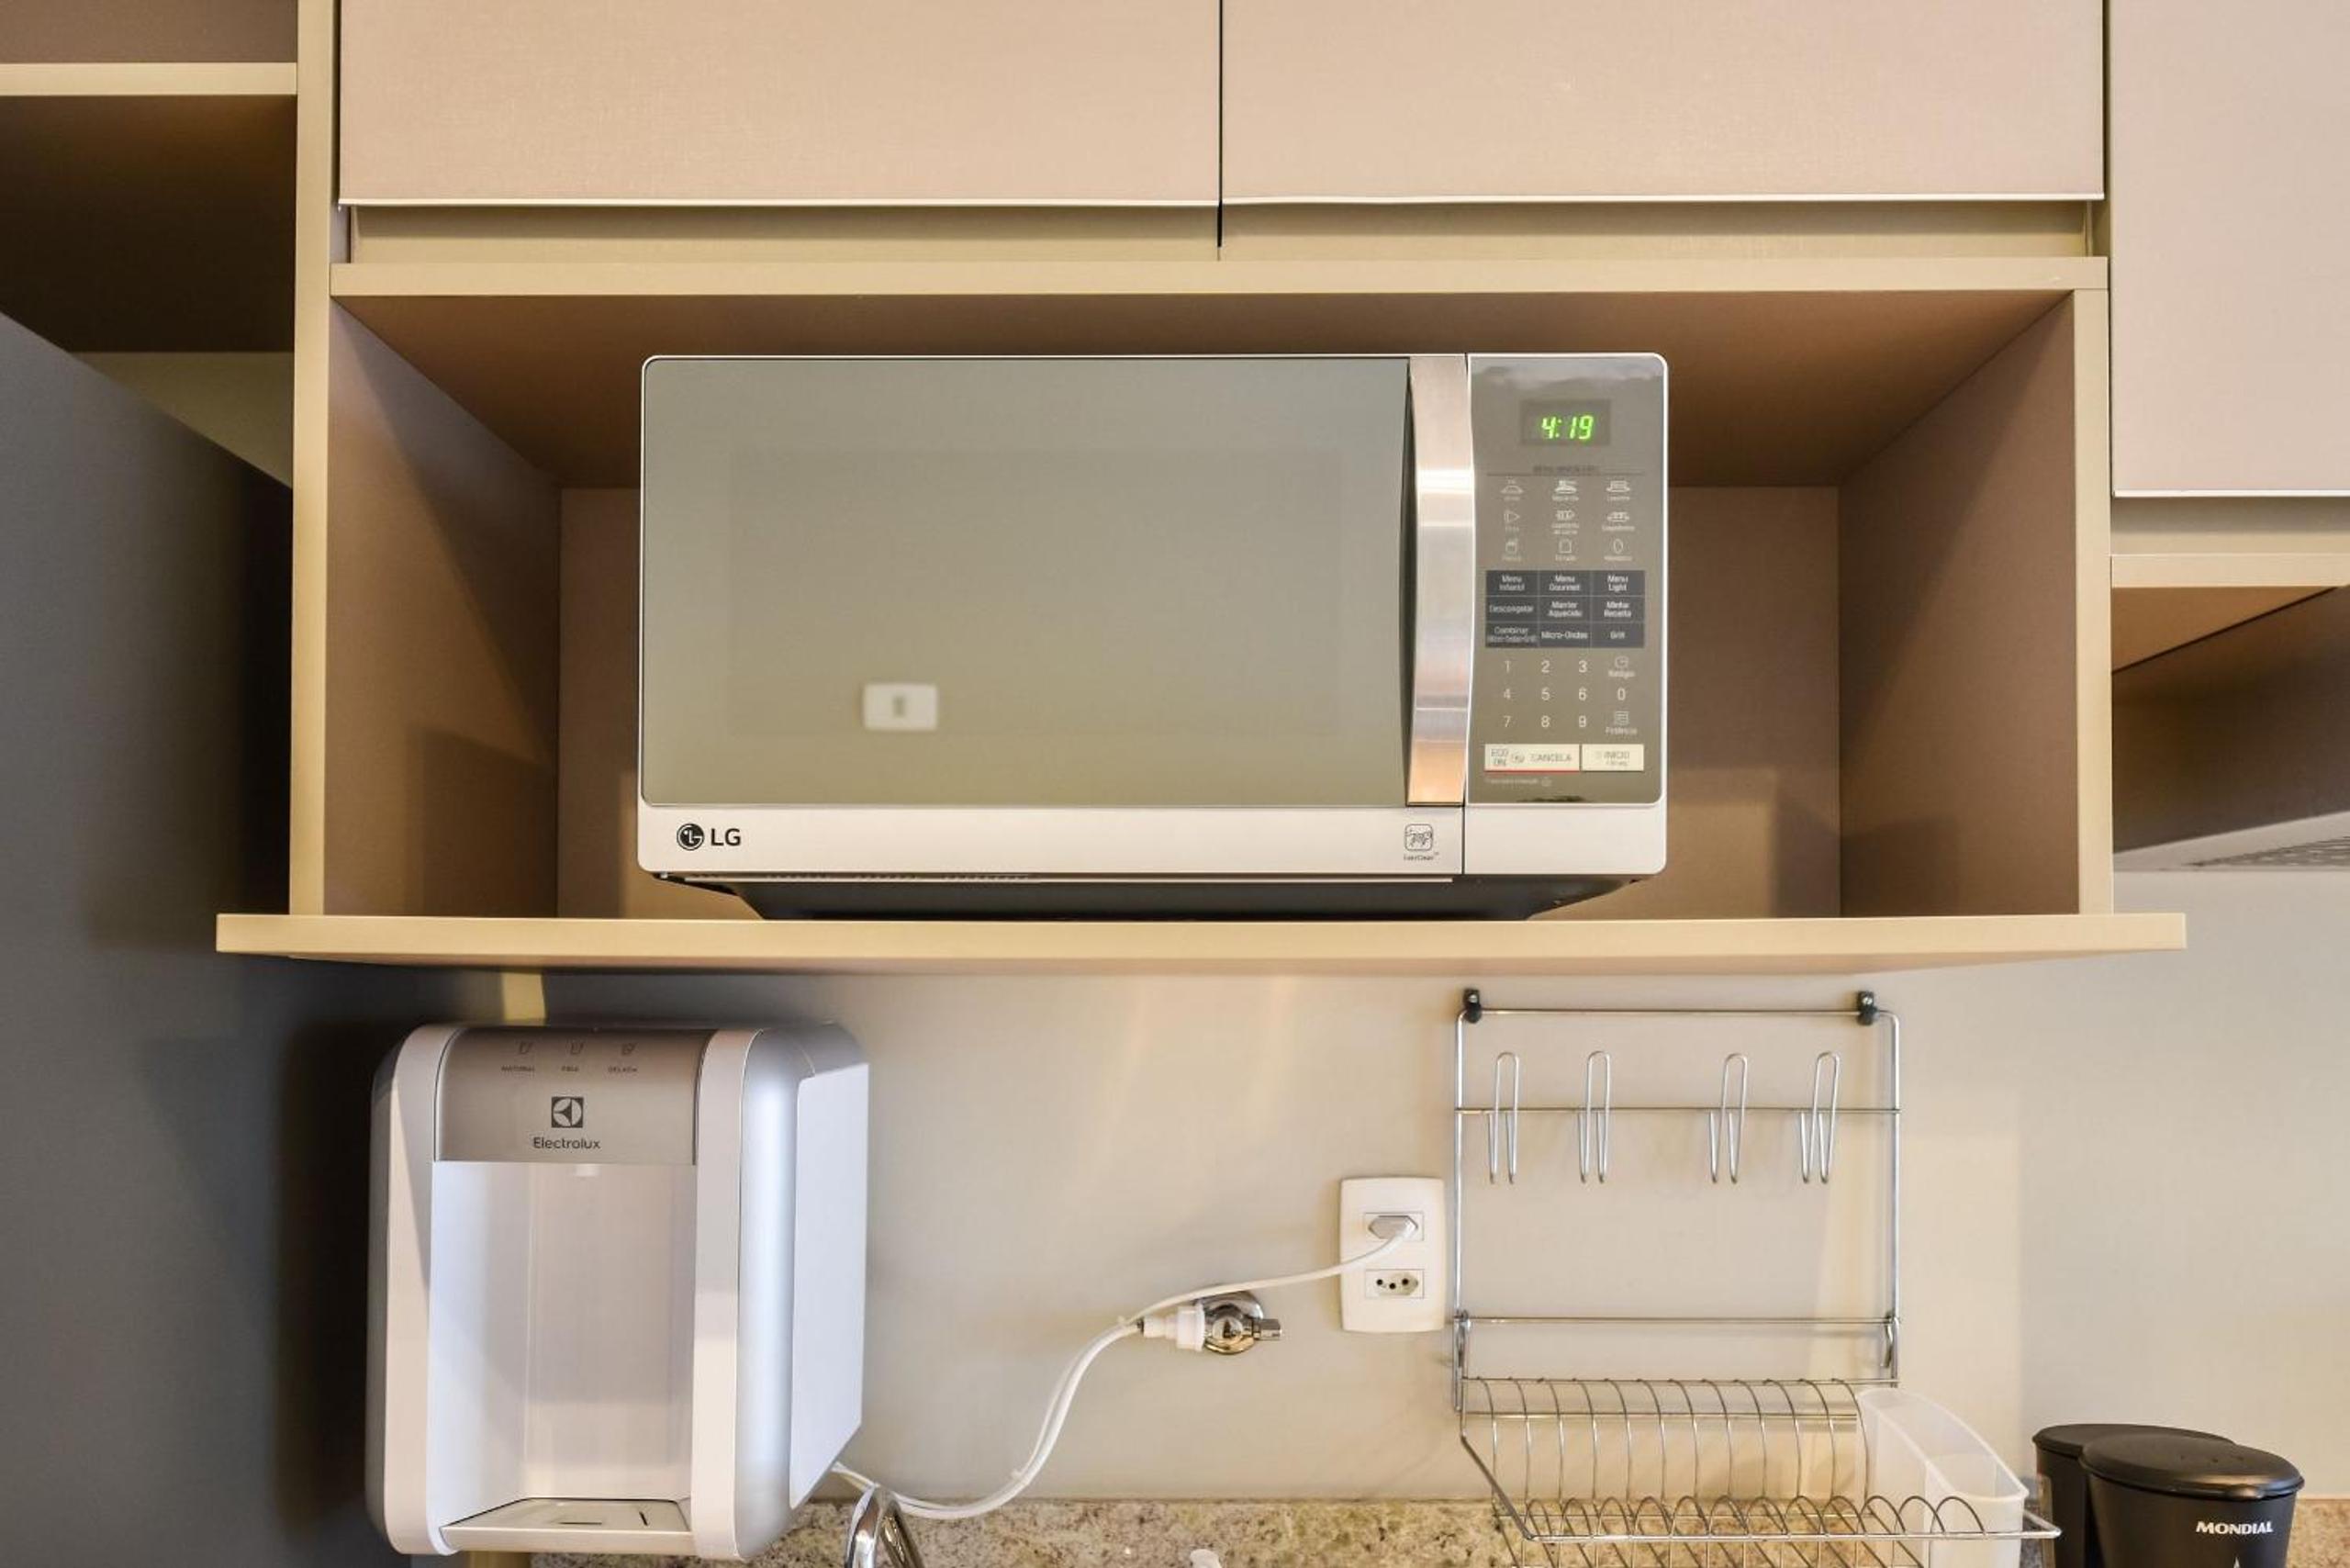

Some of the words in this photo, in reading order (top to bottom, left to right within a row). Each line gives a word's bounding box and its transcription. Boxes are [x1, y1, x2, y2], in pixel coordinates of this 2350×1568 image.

[1541, 415, 1594, 440] 4:19
[1502, 575, 1522, 583] Menu
[1555, 575, 1575, 583] Menu
[1607, 575, 1628, 583] Menu
[1549, 583, 1581, 591] Gourmet
[1608, 583, 1627, 593] Light
[1504, 660, 1511, 673] 1
[1541, 660, 1550, 673] 2
[1578, 660, 1587, 673] 3
[1504, 688, 1511, 700] 4
[1541, 688, 1550, 700] 5
[1578, 688, 1587, 700] 6
[1504, 715, 1511, 727] 7
[1541, 715, 1550, 727] 8
[1578, 715, 1587, 727] 9
[1530, 752, 1572, 763] CANCELA
[711, 828, 741, 846] LG
[532, 1136, 601, 1149] Electrolux
[2195, 1520, 2275, 1535] MONDIAL
